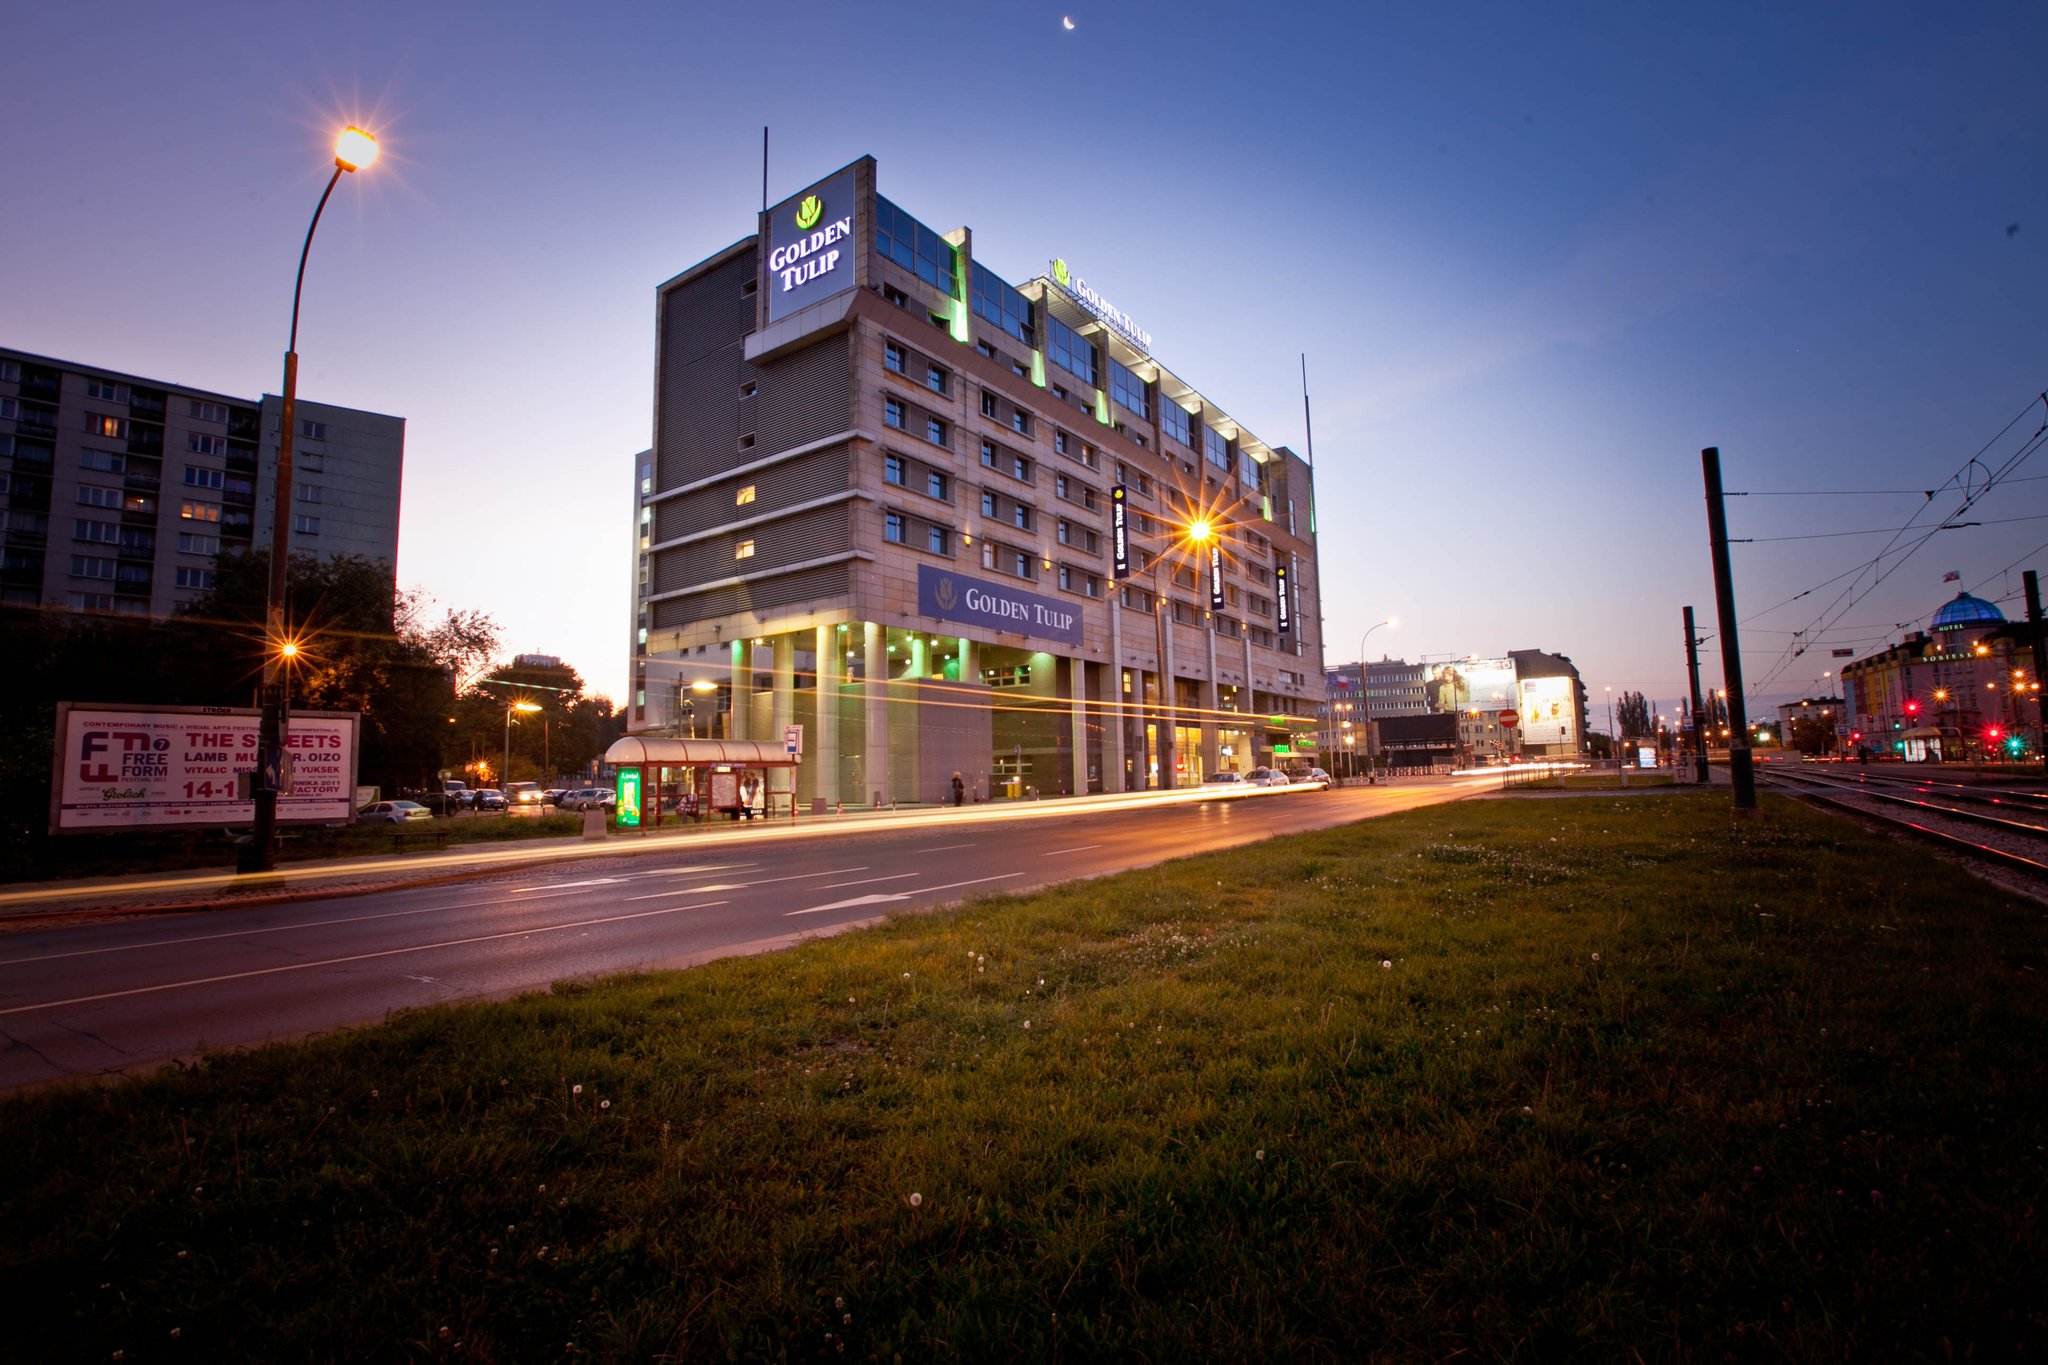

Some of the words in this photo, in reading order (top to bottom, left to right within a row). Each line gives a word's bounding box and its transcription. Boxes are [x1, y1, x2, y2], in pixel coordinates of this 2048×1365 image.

[769, 216, 850, 272] GOLDEN
[780, 249, 840, 292] TULIP
[1076, 278, 1121, 324] GOLDEN
[1122, 313, 1152, 347] TULIP
[1115, 503, 1123, 527] TULIP
[1116, 527, 1125, 560] GOLDEN
[966, 588, 1029, 621] GOLDEN
[1034, 604, 1073, 630] TULIP
[1939, 624, 1964, 632] HOTEL
[83, 721, 151, 729] CONTEMPORARY
[186, 733, 234, 747] THE
[242, 734, 341, 748] SEETS
[123, 753, 168, 765] FREE
[185, 753, 227, 762] LAMB
[309, 753, 341, 762] OIZO
[121, 766, 168, 777] FORM
[302, 766, 340, 774] YUKSEK
[102, 787, 147, 801] Grolsch
[183, 781, 238, 798] 14-1
